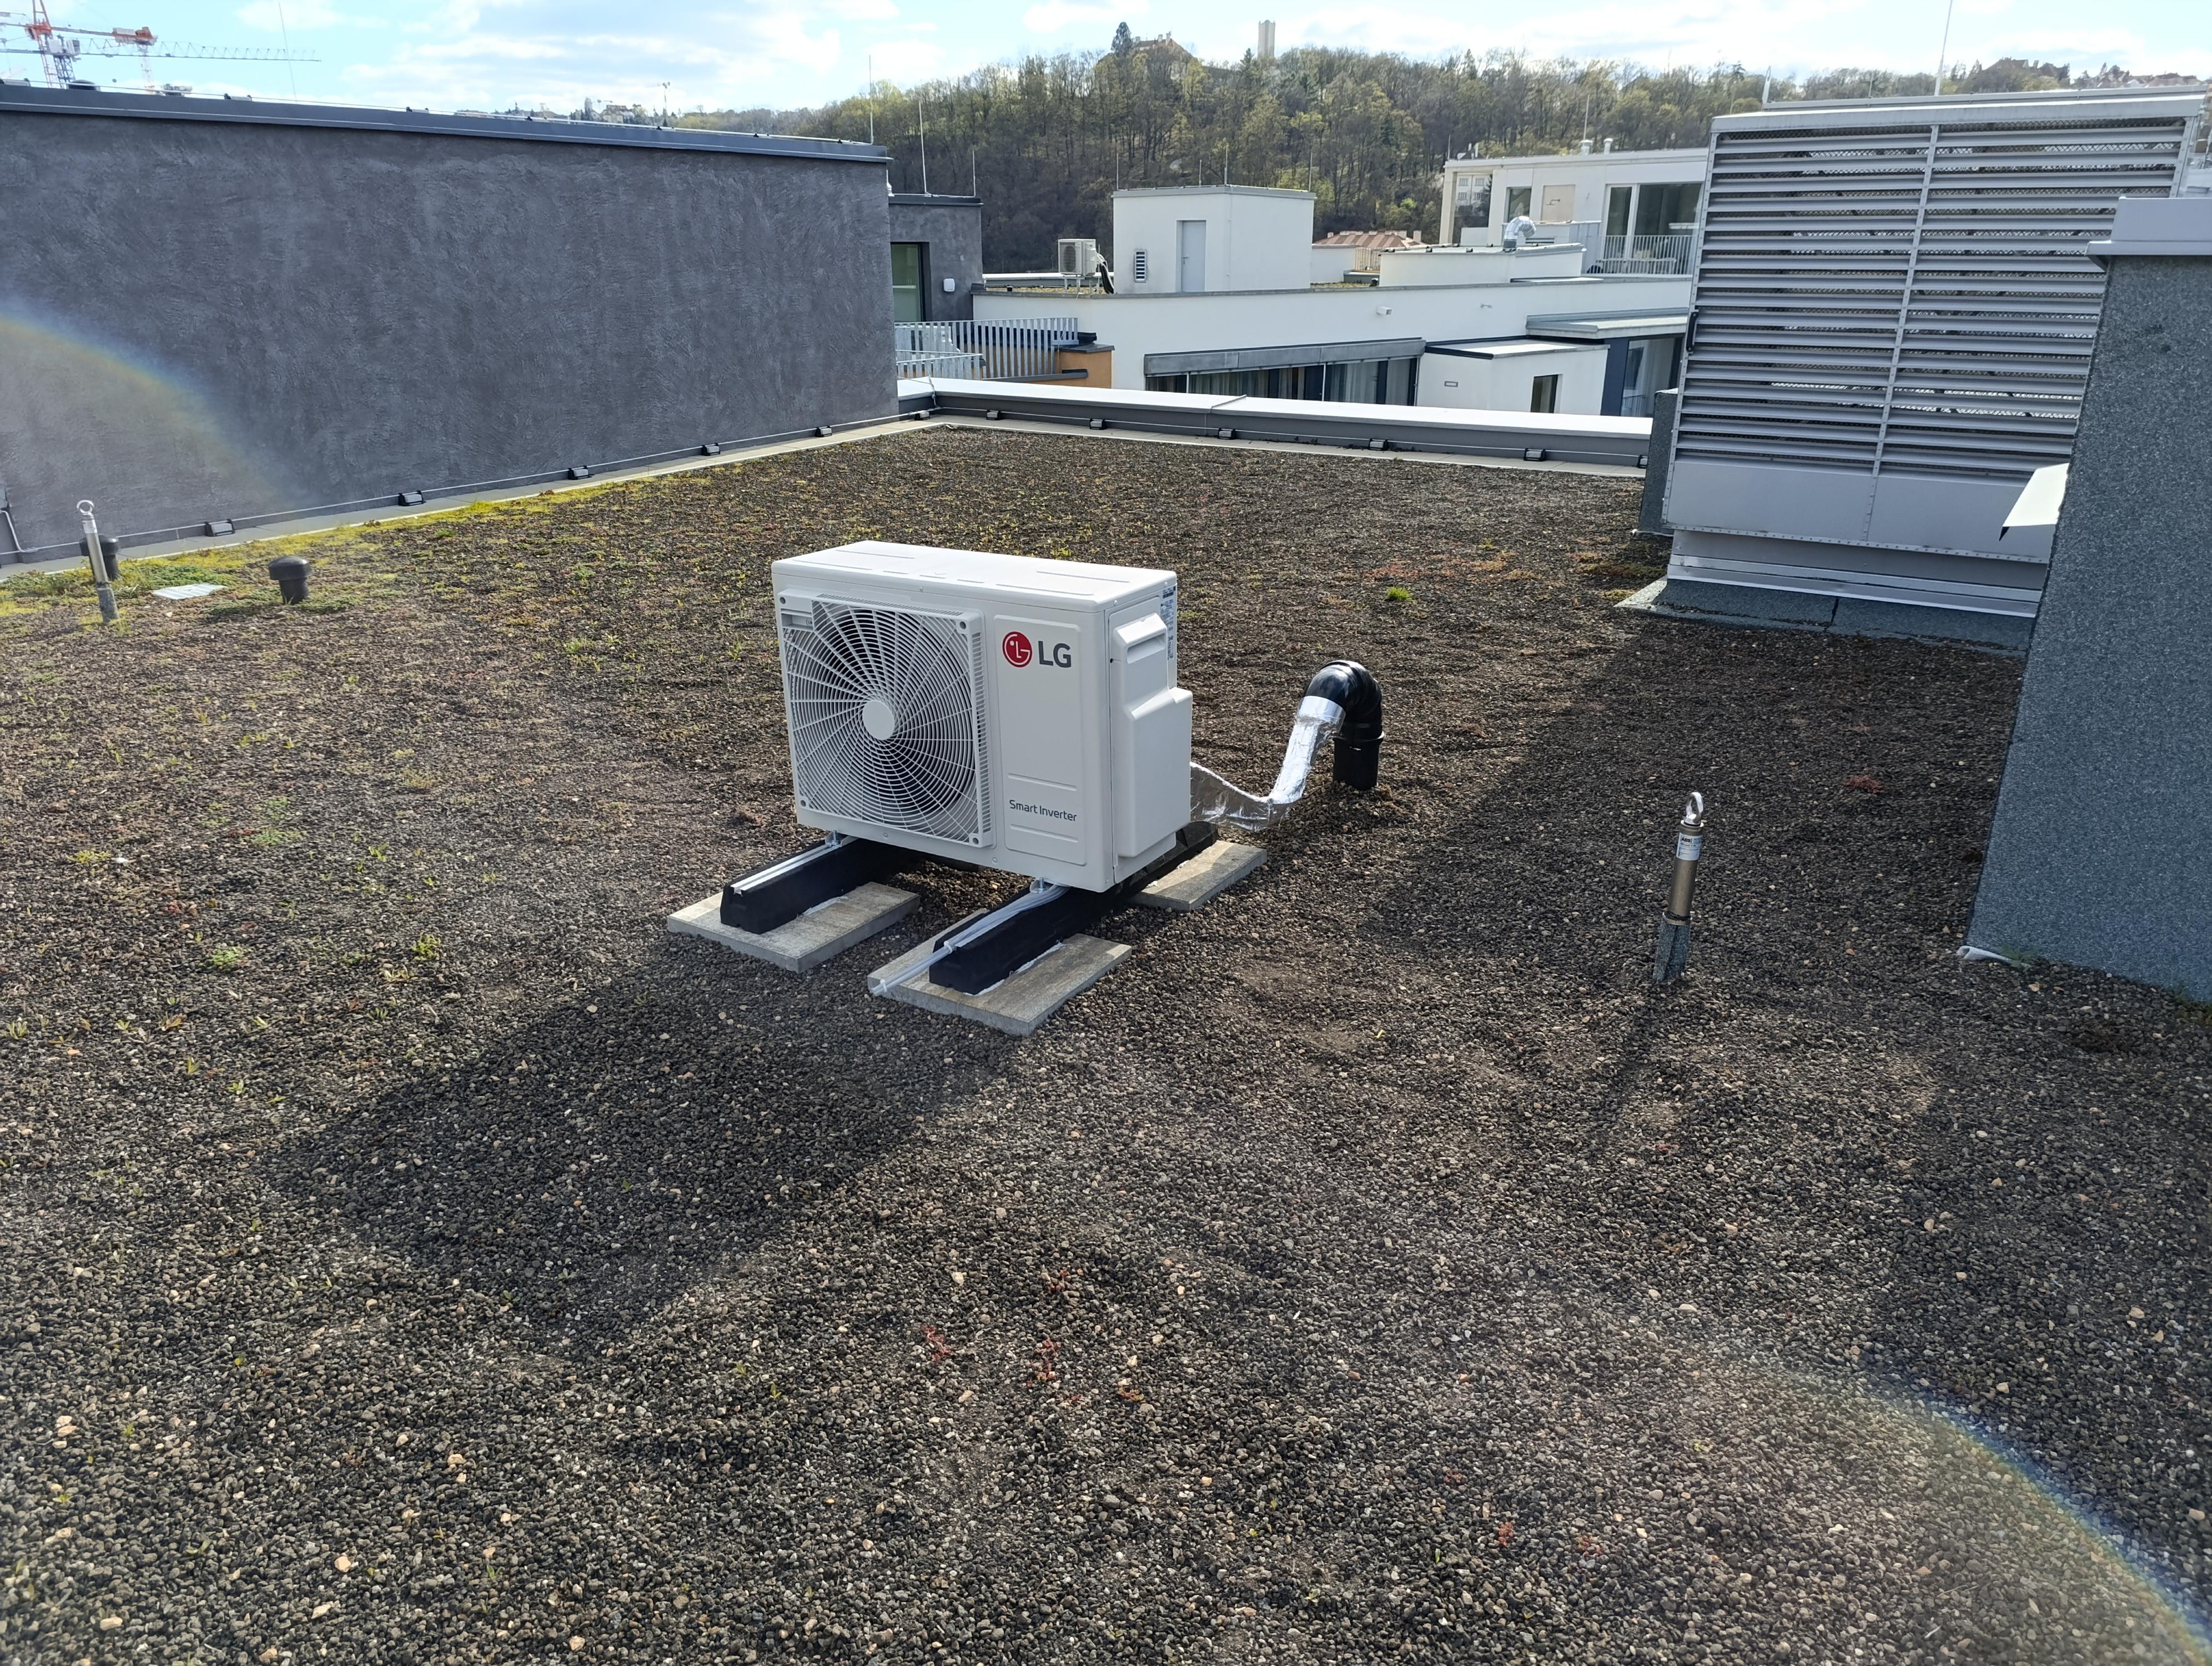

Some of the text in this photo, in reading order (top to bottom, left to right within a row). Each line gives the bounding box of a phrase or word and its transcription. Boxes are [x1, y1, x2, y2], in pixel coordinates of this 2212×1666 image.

[1038, 640, 1072, 668] LG
[1009, 800, 1077, 821] Smart Inverter
